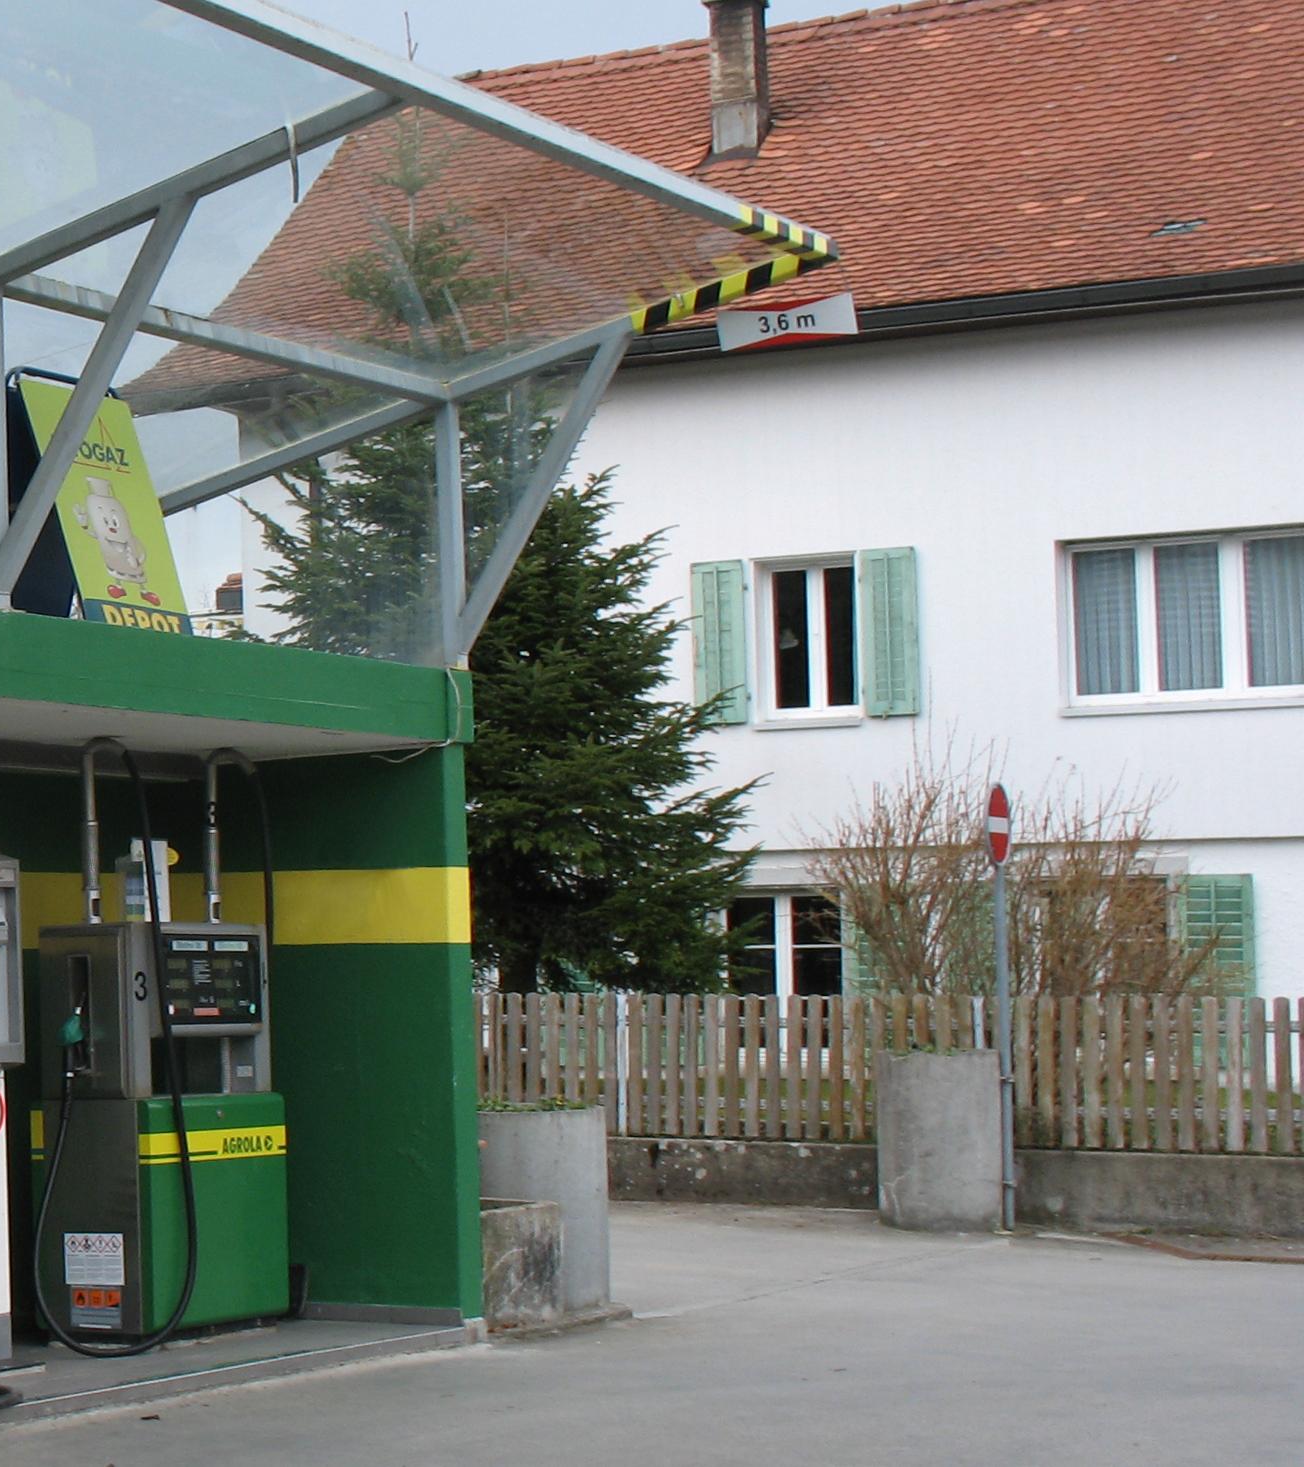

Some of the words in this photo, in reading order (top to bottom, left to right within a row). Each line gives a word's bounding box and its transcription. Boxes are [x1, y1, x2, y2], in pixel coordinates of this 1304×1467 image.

[758, 313, 790, 334] 3,6
[796, 314, 816, 328] m
[134, 971, 148, 1001] 3
[222, 1136, 263, 1154] AGROLA
